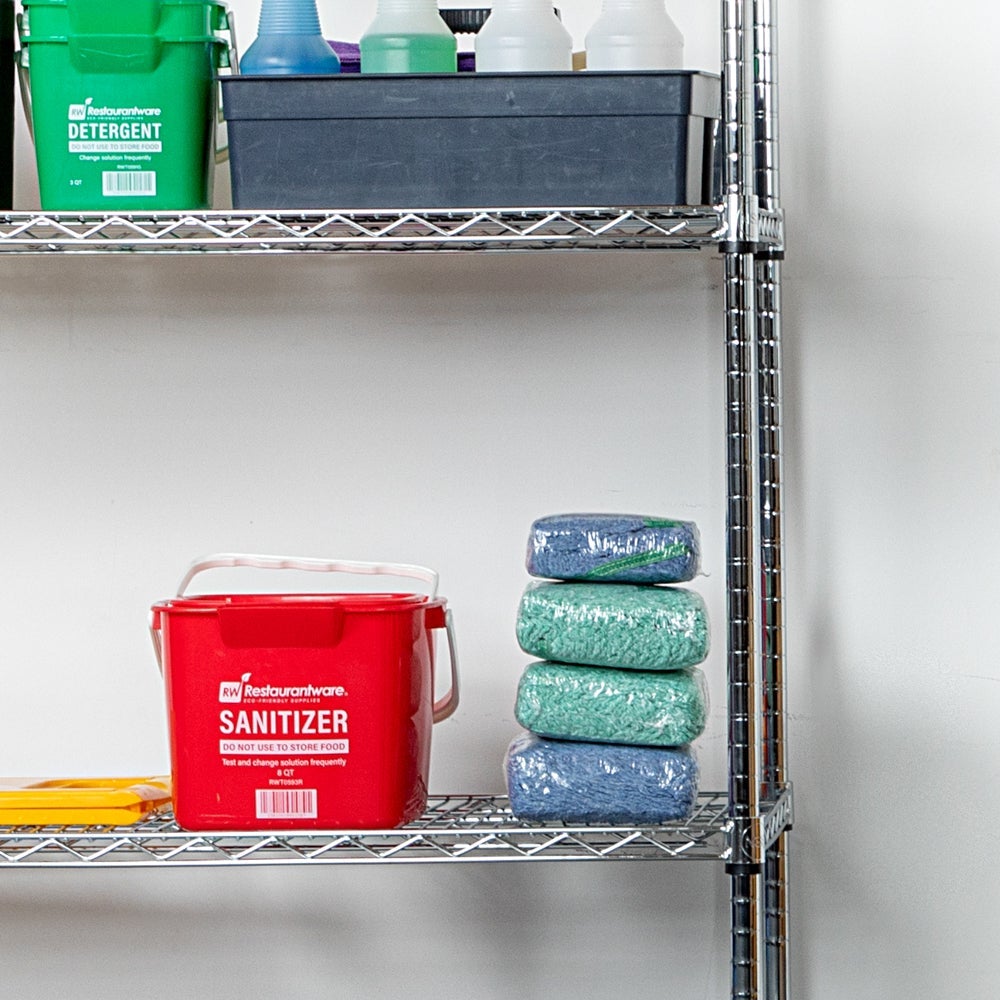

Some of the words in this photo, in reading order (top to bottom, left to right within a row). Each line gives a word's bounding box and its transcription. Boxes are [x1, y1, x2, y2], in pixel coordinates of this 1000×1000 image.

[87, 106, 161, 116] Restaurantware
[68, 122, 162, 139] DETERGENT
[223, 687, 240, 698] RW
[219, 709, 348, 735] SANITIZER
[257, 744, 275, 752] USE
[290, 743, 319, 751] STORE
[320, 742, 346, 751] FOOD
[222, 758, 236, 767] Test
[237, 758, 251, 767] and
[252, 758, 279, 768] change
[280, 758, 309, 767] solution
[310, 757, 347, 768] frequently
[277, 769, 283, 777] 8
[283, 769, 295, 777] QT
